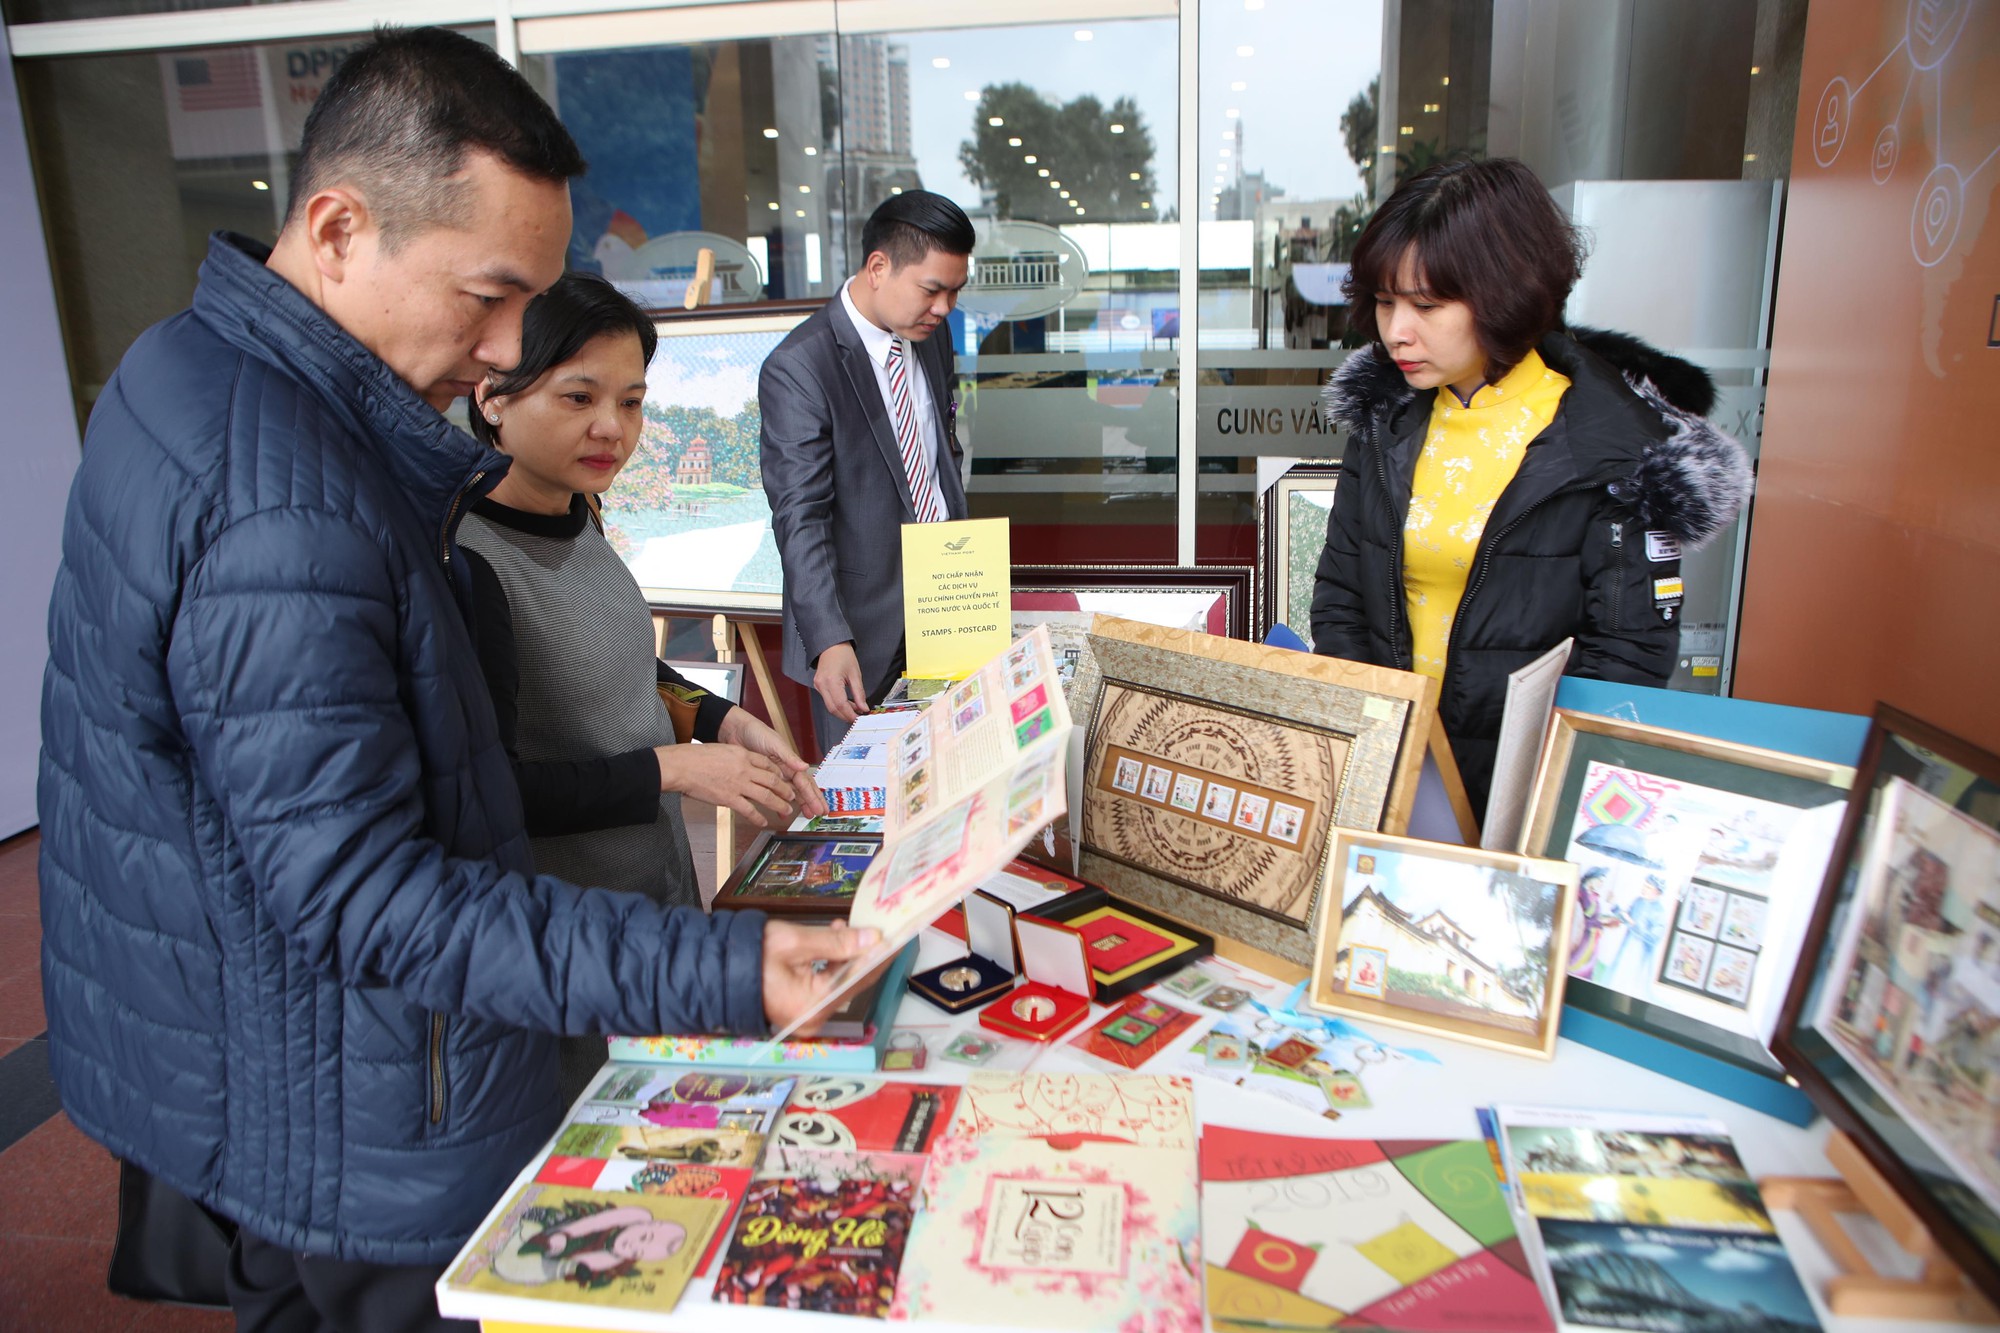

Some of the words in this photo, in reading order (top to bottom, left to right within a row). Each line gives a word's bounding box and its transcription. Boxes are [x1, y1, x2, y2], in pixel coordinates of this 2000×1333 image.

[1217, 408, 1283, 434] CUNG
[946, 570, 963, 579] CHẤP
[964, 570, 984, 579] NHẬN
[968, 582, 978, 590] VỤ
[941, 604, 961, 613] NƯỚC
[972, 601, 991, 611] QUỐC
[992, 601, 1001, 609] TẾ
[921, 628, 952, 637] STAMPS
[958, 624, 997, 634] POSTCARD
[1246, 1168, 1391, 1213] 2019
